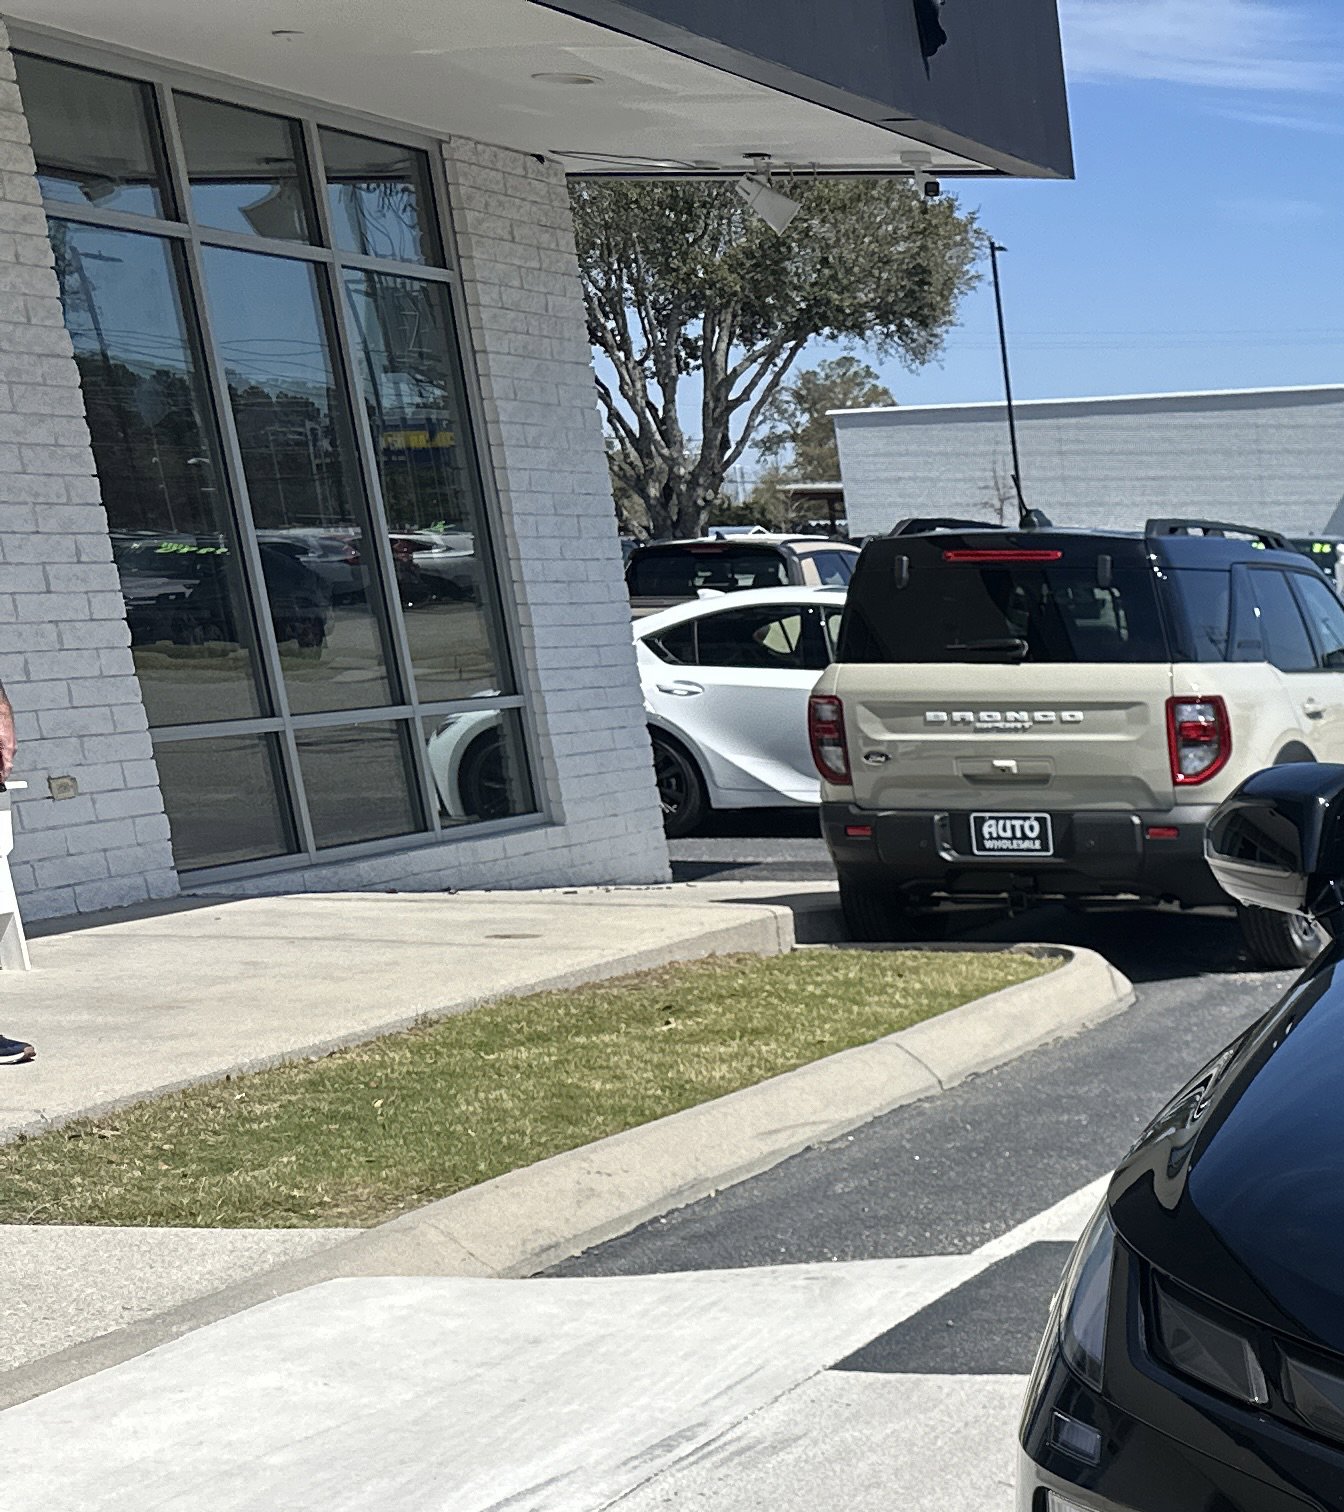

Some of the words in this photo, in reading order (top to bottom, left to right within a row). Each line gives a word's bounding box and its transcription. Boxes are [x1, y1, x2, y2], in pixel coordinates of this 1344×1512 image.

[925, 711, 1084, 722] BRONCO
[982, 819, 1040, 840] AUTO
[983, 839, 1042, 851] WHOLESALE
